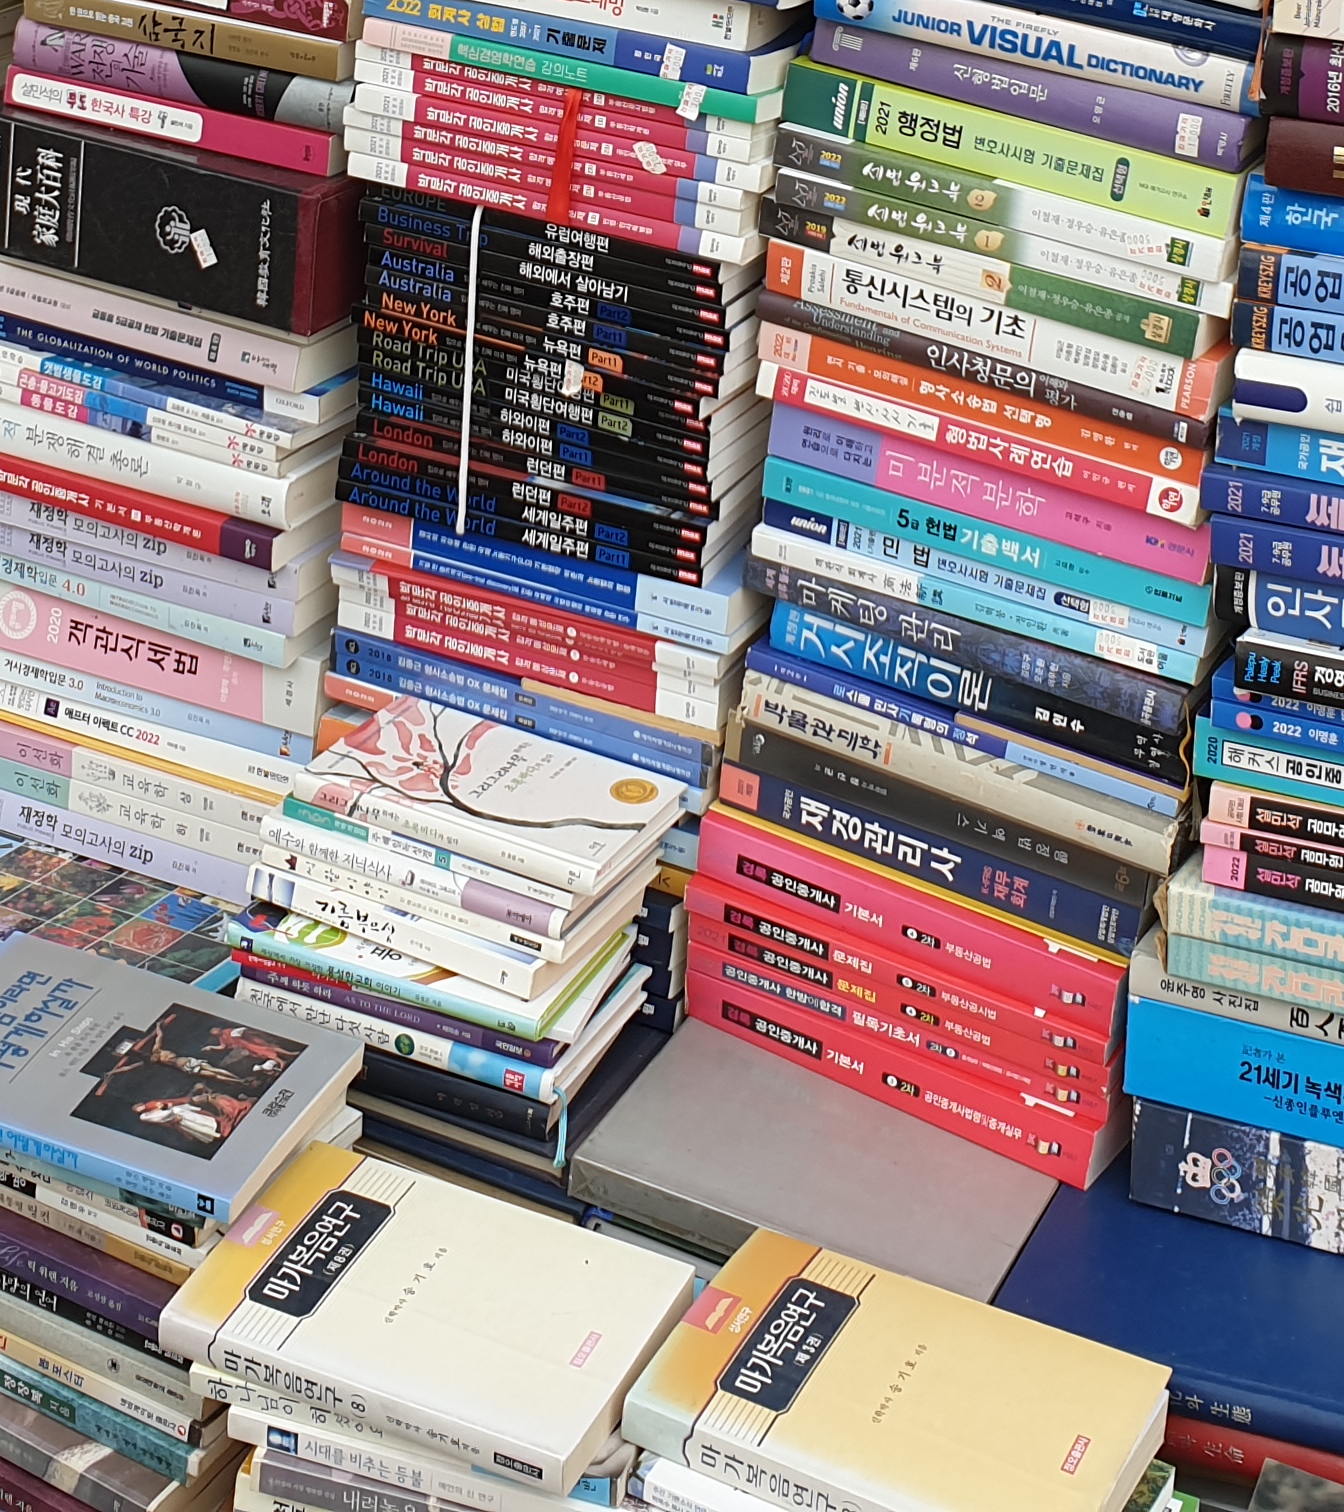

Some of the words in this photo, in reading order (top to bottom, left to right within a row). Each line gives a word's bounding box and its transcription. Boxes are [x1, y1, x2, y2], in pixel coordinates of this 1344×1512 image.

[892, 8, 961, 38] JUNIOR
[966, 19, 1083, 69] VISUAL
[1086, 53, 1204, 93] DICTIONARY
[1016, 19, 1059, 38] FIREFLY
[832, 83, 849, 130] union
[897, 110, 964, 149] 행정법
[974, 135, 1035, 164] 변호사시험
[1041, 146, 1105, 181] 기출문제집
[382, 229, 448, 258] Survival
[544, 224, 609, 252] 유럽여행편
[381, 251, 454, 283] Australia
[381, 293, 415, 318] New
[418, 300, 456, 326] York
[839, 297, 896, 324] Fundamentals
[912, 316, 982, 350] Communication
[984, 337, 1022, 358] Systems
[842, 273, 974, 325] 통신시스템의
[980, 303, 1026, 339] 기초
[37, 331, 113, 360] GLOBALIZATION
[116, 351, 130, 364] OF
[133, 355, 169, 375] WORLD
[172, 366, 217, 388] POLITICS
[926, 344, 1037, 392] 인사청문의
[371, 373, 423, 401] Hawaii
[1181, 364, 1196, 410] PEARSON
[944, 424, 1073, 478] 형법사례연습
[29, 531, 68, 559] 재정학
[72, 549, 137, 582] 모의고사의
[140, 568, 164, 589] zip
[800, 797, 961, 881] 재경관리사
[770, 872, 836, 909] 공인중개사
[844, 903, 883, 928] 기본서
[1239, 1060, 1298, 1092] 21세기
[261, 1200, 362, 1303] 마가복음연구
[732, 1290, 827, 1397] 마가복음연구
